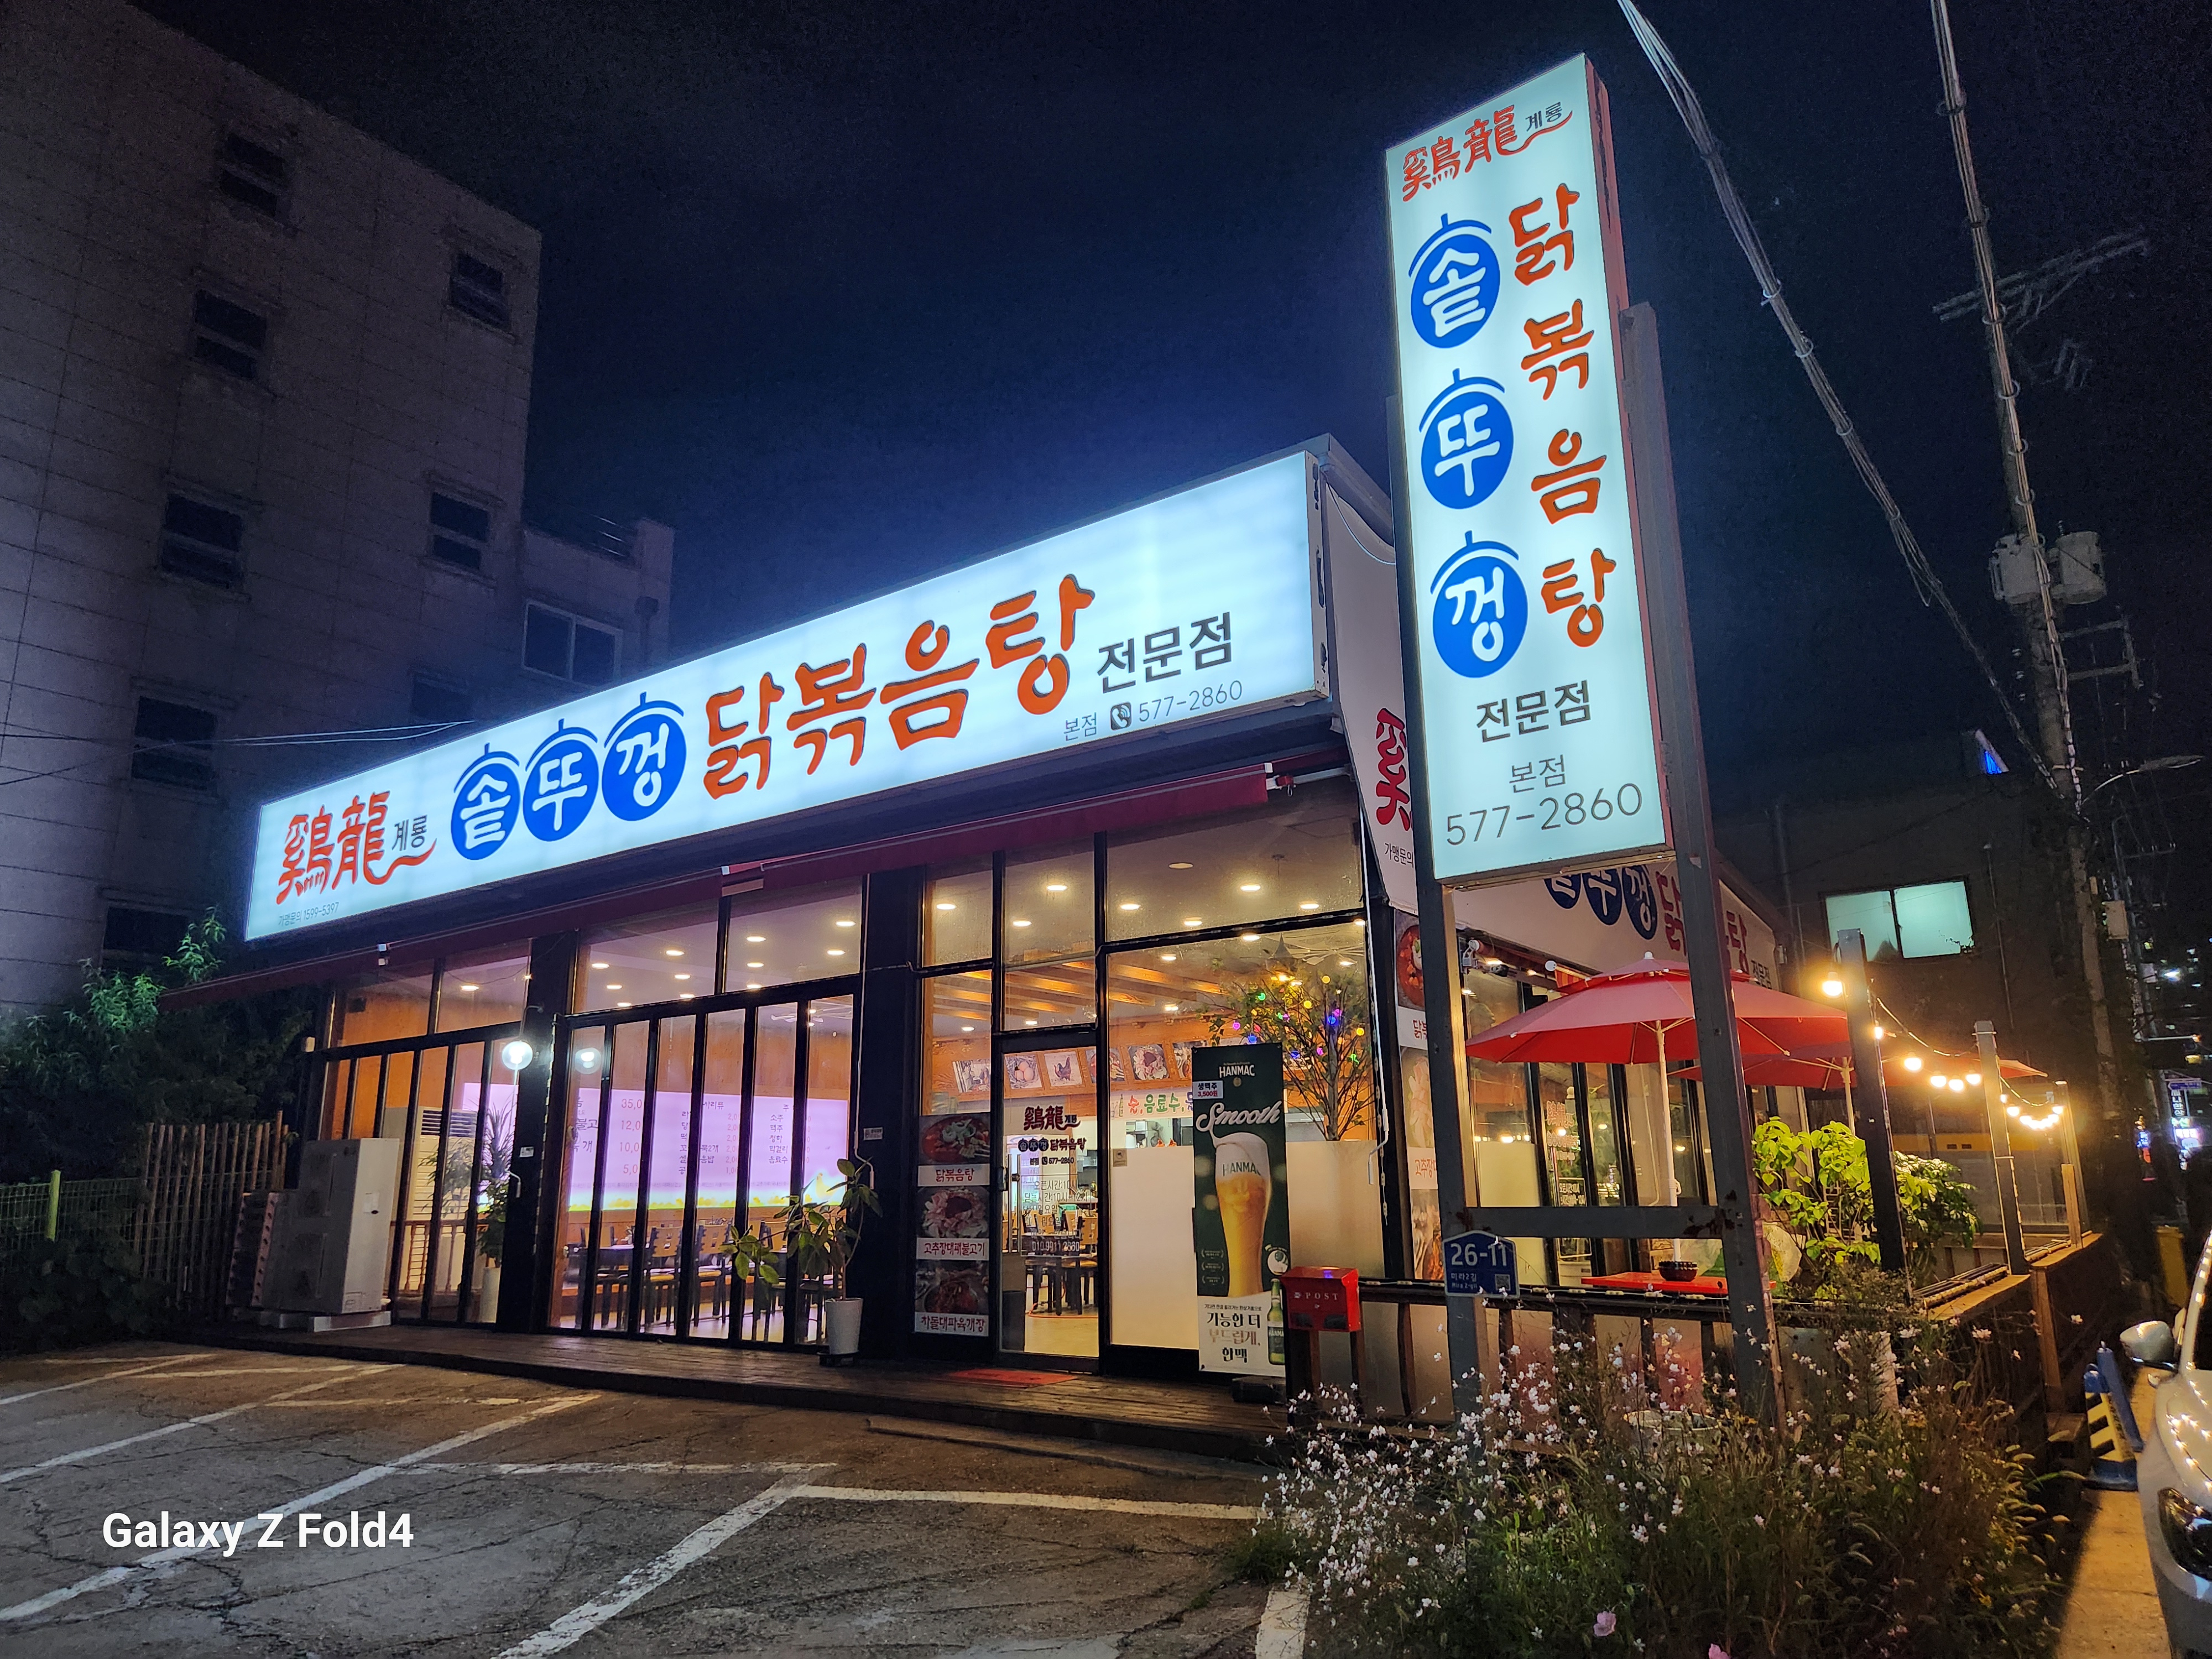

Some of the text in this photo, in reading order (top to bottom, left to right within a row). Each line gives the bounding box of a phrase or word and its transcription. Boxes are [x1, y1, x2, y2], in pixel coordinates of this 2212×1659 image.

[1526, 102, 1563, 131] 계룡
[704, 574, 1095, 800] 닭볶음탕
[1097, 612, 1232, 693] 전문점
[1064, 680, 1242, 741] 본점 577-2860
[1477, 680, 1590, 743] 전문점
[1510, 754, 1566, 794] 본점
[1447, 784, 1642, 846] 577-2860
[392, 815, 427, 851] 계룡
[1385, 843, 1414, 868] 가맹문의
[278, 901, 339, 926] 가맹문의 1599-5397
[1219, 1065, 1255, 1078] HANMAC
[770, 1124, 783, 1133] 맥주
[1196, 1100, 1282, 1133] Smooth
[769, 1145, 788, 1154] 막걸리
[769, 1156, 788, 1164] 음료수
[936, 1168, 974, 1182] 닭볶음탕
[1451, 1243, 1507, 1266] 26-11
[1451, 1273, 1477, 1282] 미라2길
[1248, 1314, 1260, 1328] 더
